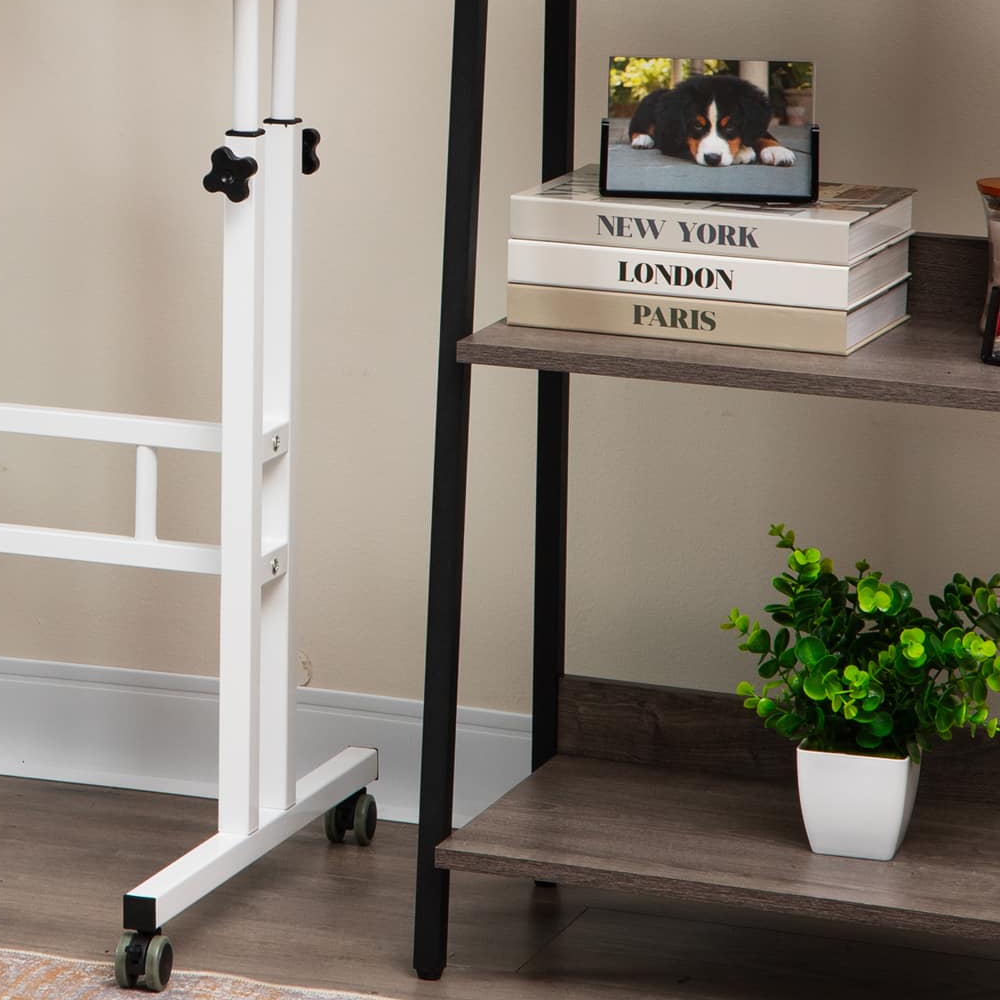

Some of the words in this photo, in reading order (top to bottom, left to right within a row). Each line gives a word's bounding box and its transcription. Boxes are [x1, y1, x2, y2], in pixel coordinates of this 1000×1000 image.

[596, 214, 666, 240] NEW
[678, 221, 760, 248] YORK
[617, 261, 734, 290] LONDON
[632, 304, 717, 331] PARIS
